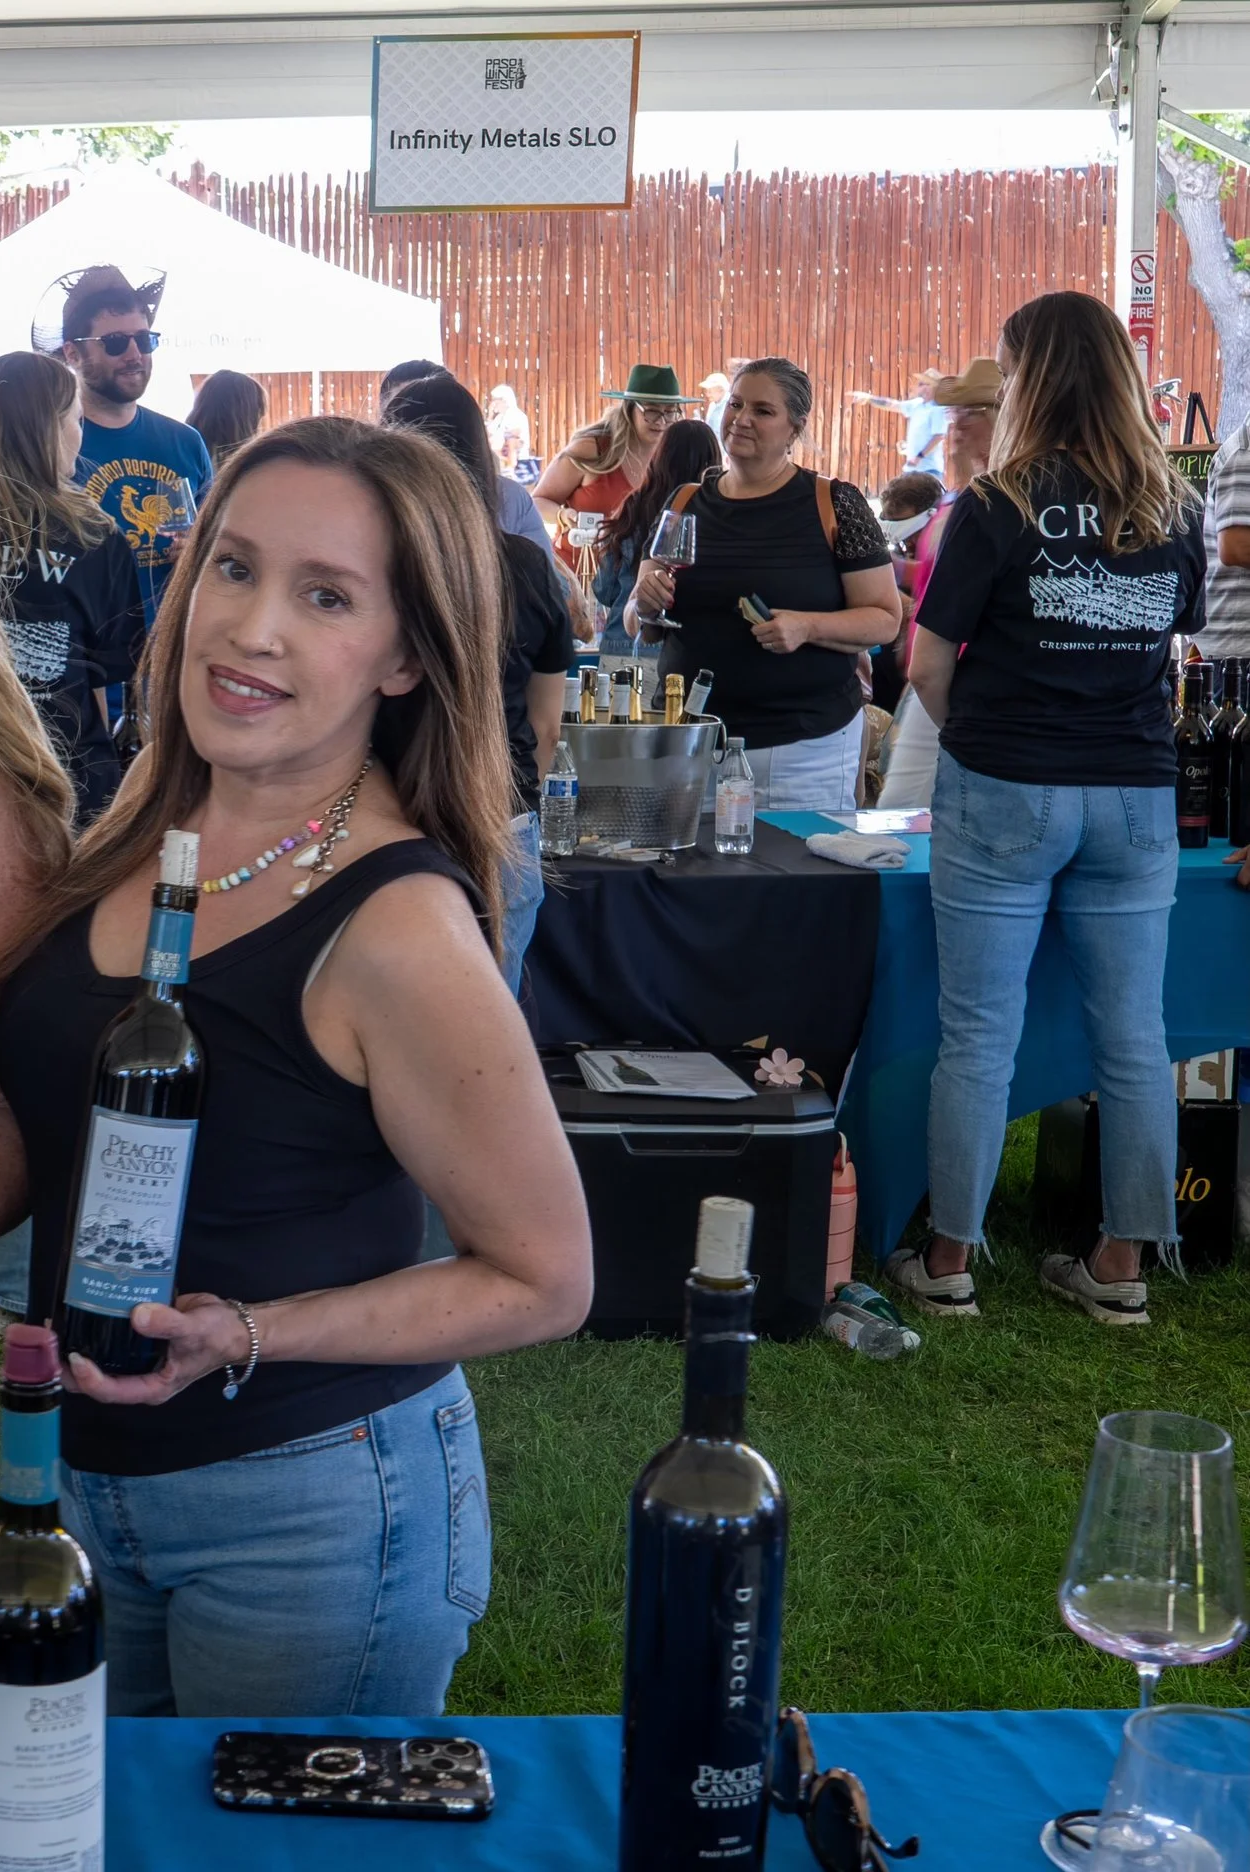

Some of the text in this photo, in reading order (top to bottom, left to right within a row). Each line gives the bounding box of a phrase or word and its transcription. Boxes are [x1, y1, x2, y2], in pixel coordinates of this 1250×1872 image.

[485, 58, 517, 69] PASO
[485, 69, 517, 80] WINE
[485, 80, 515, 90] FEST
[389, 126, 617, 154] Infinity Metals SLO
[1135, 286, 1152, 295] NO
[1130, 306, 1154, 319] FIRE
[98, 459, 125, 484] BOO
[122, 457, 183, 493] RECORDS
[1039, 640, 1095, 651] CRUSHING
[1097, 641, 1109, 651] IT
[1110, 641, 1142, 652] SINCE
[107, 1134, 178, 1161] PEACHY
[100, 1148, 178, 1175] CANYON
[103, 1171, 170, 1187] WINERY
[1174, 1167, 1211, 1202] lo
[728, 1587, 753, 1709] D BLOCK
[698, 1761, 763, 1784] PEACHY
[690, 1775, 764, 1797] CANYON
